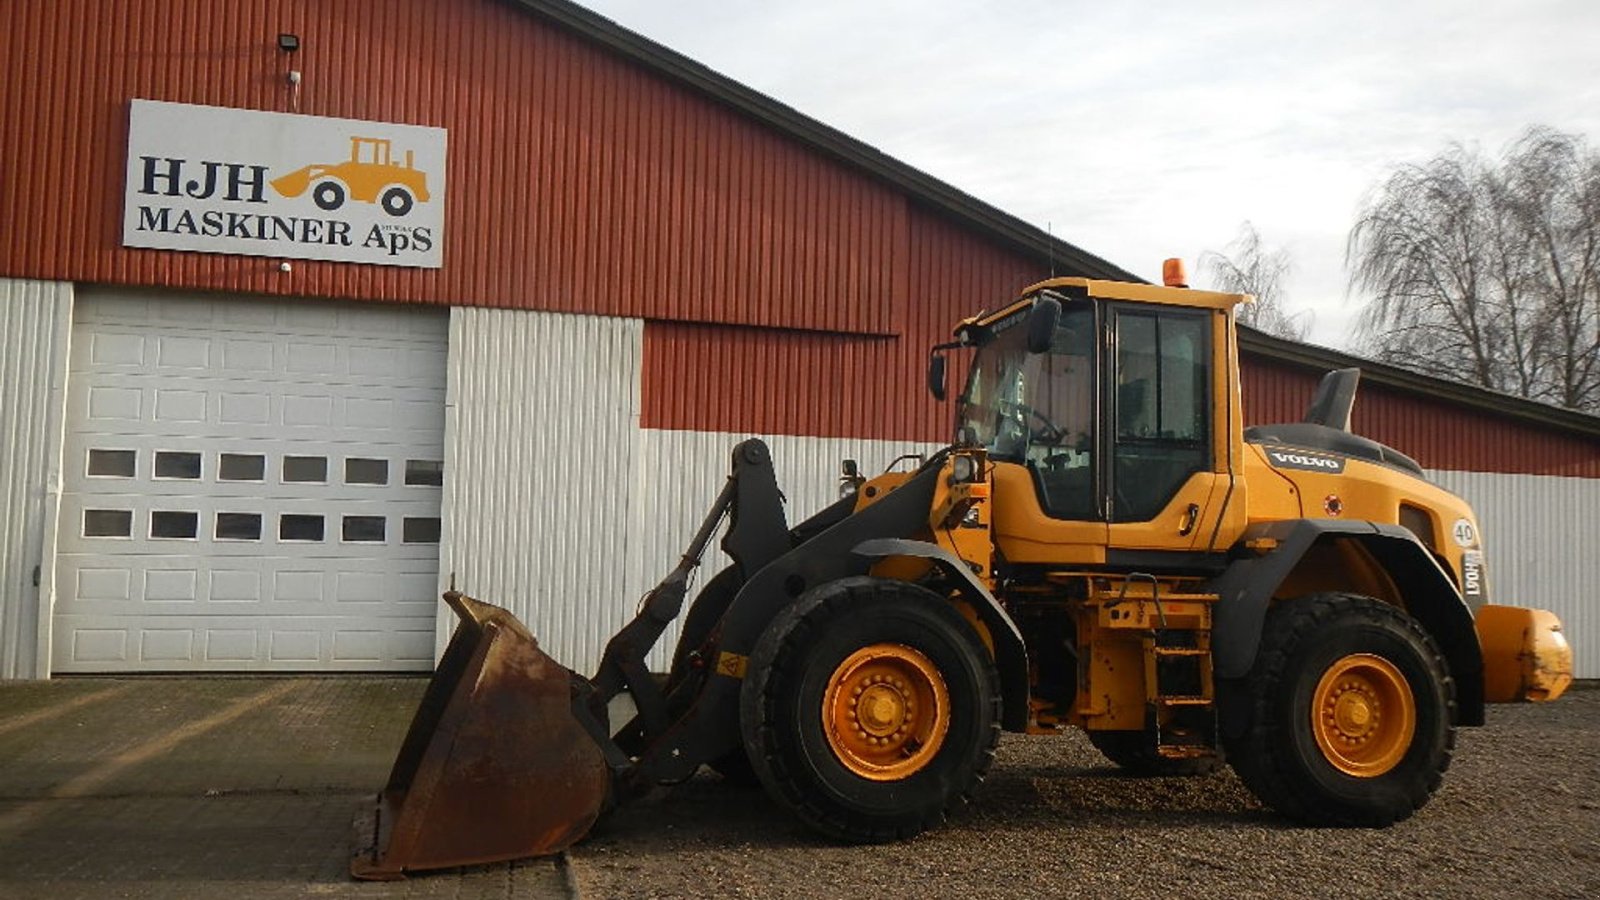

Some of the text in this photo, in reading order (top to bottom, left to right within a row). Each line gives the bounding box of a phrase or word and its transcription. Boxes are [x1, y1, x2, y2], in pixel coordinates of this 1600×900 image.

[138, 156, 269, 203] HJH
[136, 206, 432, 255] MASKINER ApS
[1271, 453, 1339, 468] VOLVO
[1456, 525, 1473, 542] 40
